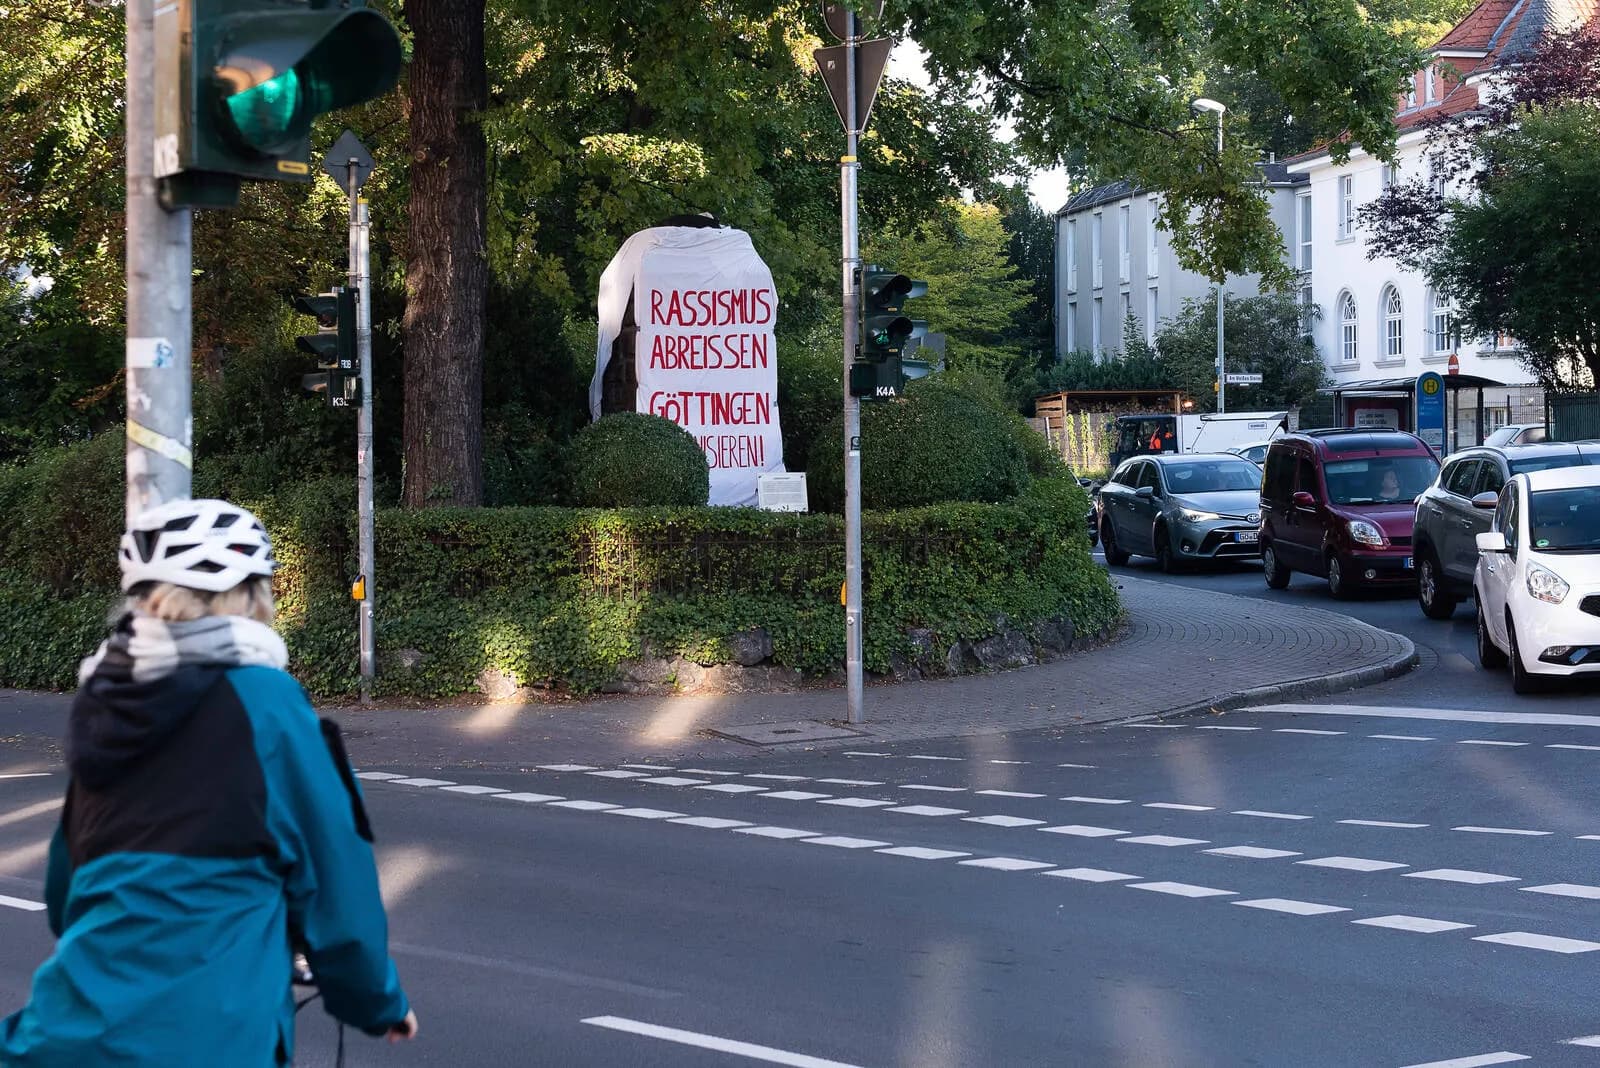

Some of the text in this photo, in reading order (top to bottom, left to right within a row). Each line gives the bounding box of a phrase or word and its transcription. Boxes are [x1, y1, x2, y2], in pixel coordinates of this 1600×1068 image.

[651, 289, 770, 326] RASSISMUS
[650, 333, 768, 370] ABREISSEN
[649, 391, 770, 425] GÖTTINGEN
[876, 386, 896, 397] K4A
